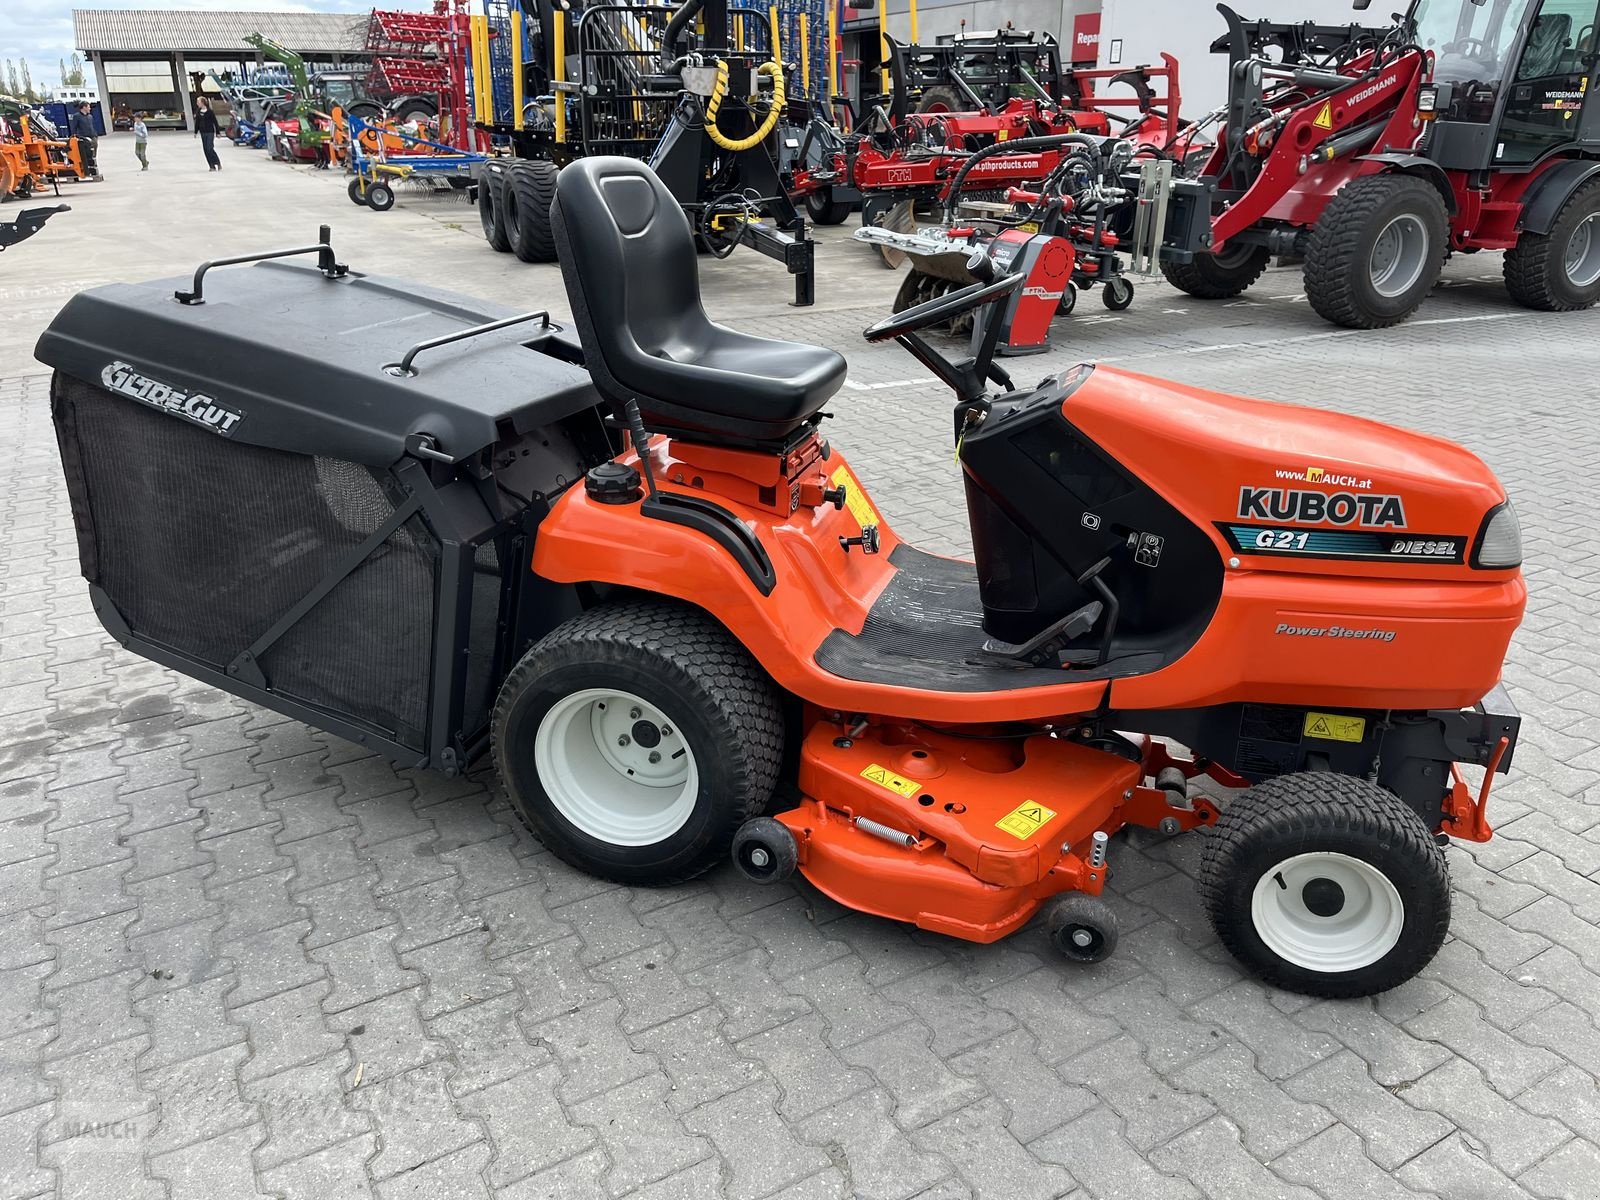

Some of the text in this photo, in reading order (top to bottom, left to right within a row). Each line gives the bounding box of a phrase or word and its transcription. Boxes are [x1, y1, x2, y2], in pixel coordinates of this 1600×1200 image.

[1346, 74, 1397, 107] WEIDEMANN
[887, 168, 912, 181] PTH
[1275, 467, 1372, 489] www.MAUCH.at
[1237, 485, 1408, 529] KUBOTA
[1255, 529, 1310, 549] G21
[1390, 540, 1457, 555] DIESEL
